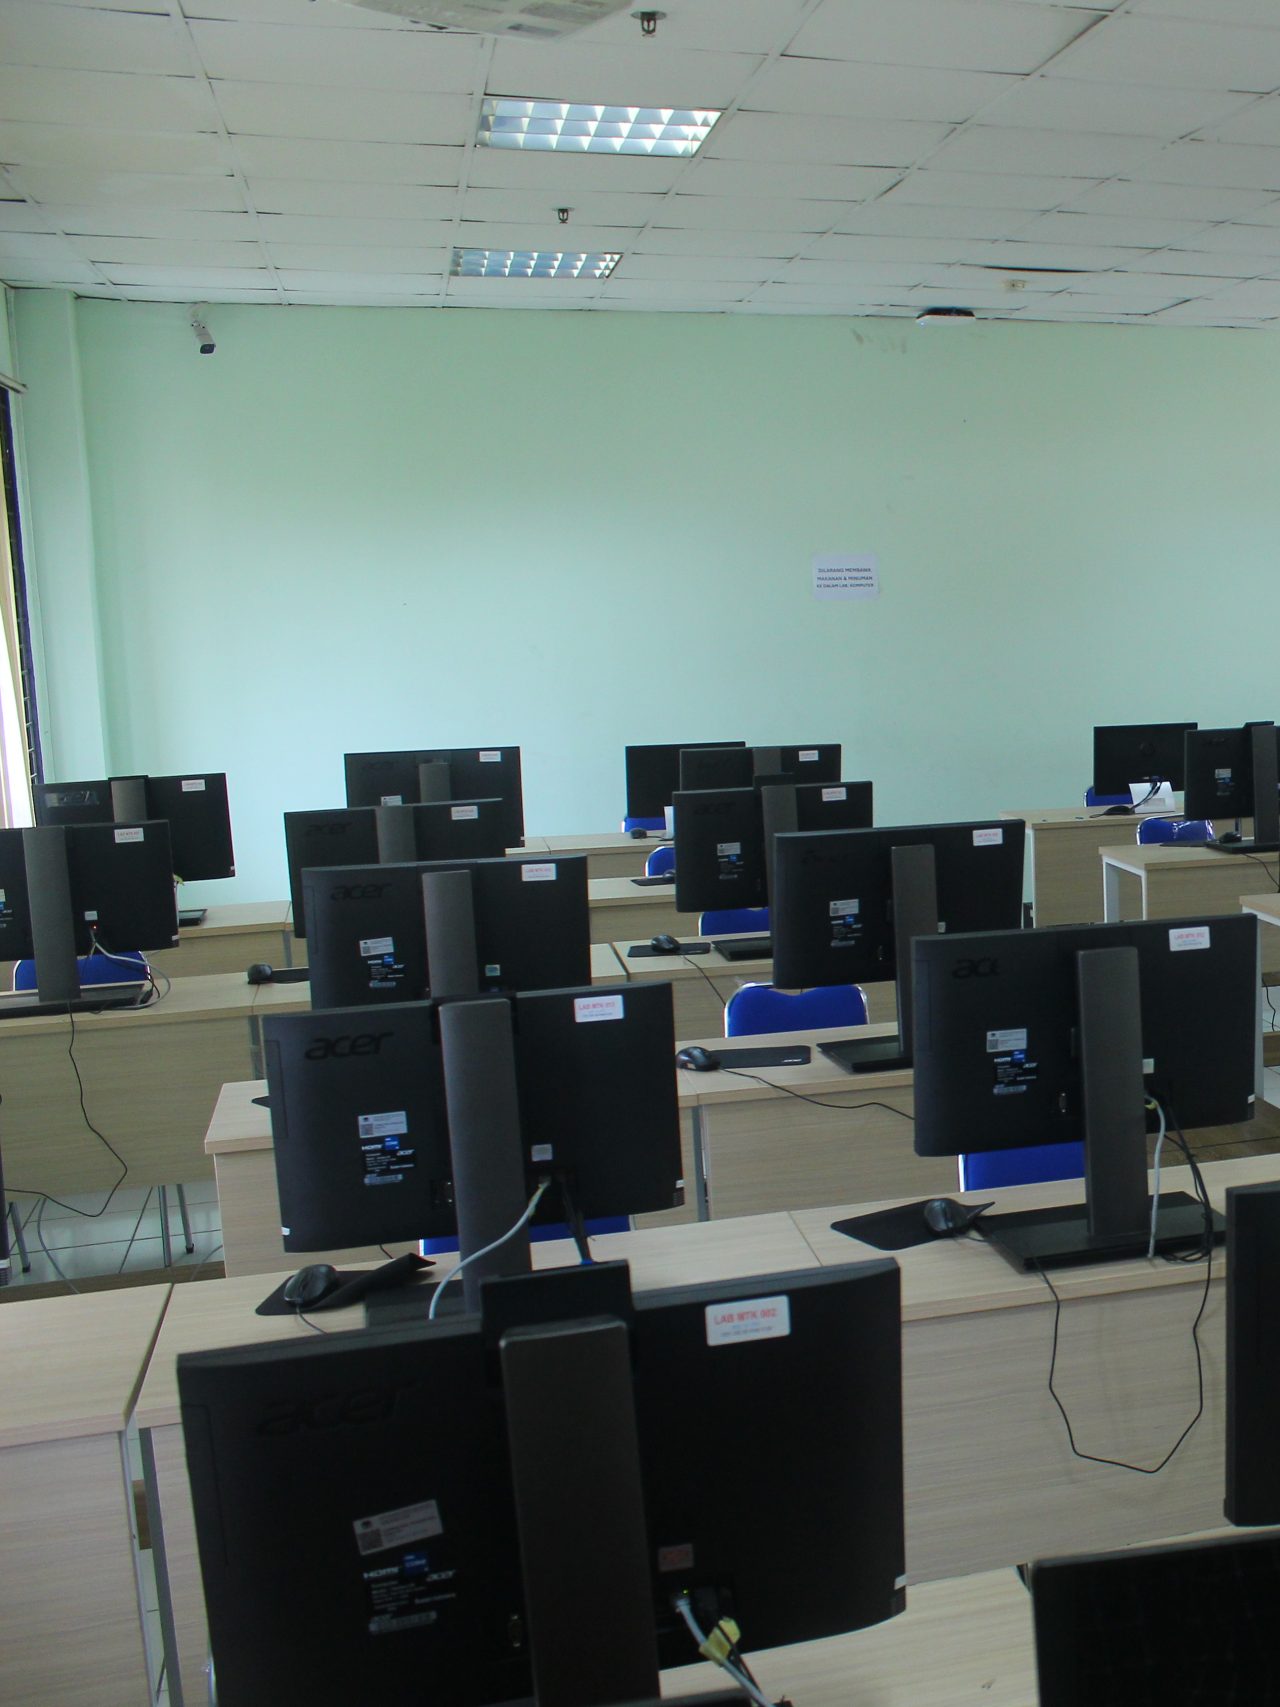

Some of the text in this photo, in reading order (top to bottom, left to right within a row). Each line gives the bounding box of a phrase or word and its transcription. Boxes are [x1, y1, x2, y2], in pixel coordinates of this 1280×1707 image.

[305, 1031, 394, 1060] acer
[713, 1313, 734, 1325] LAB
[737, 1311, 757, 1322] MTK
